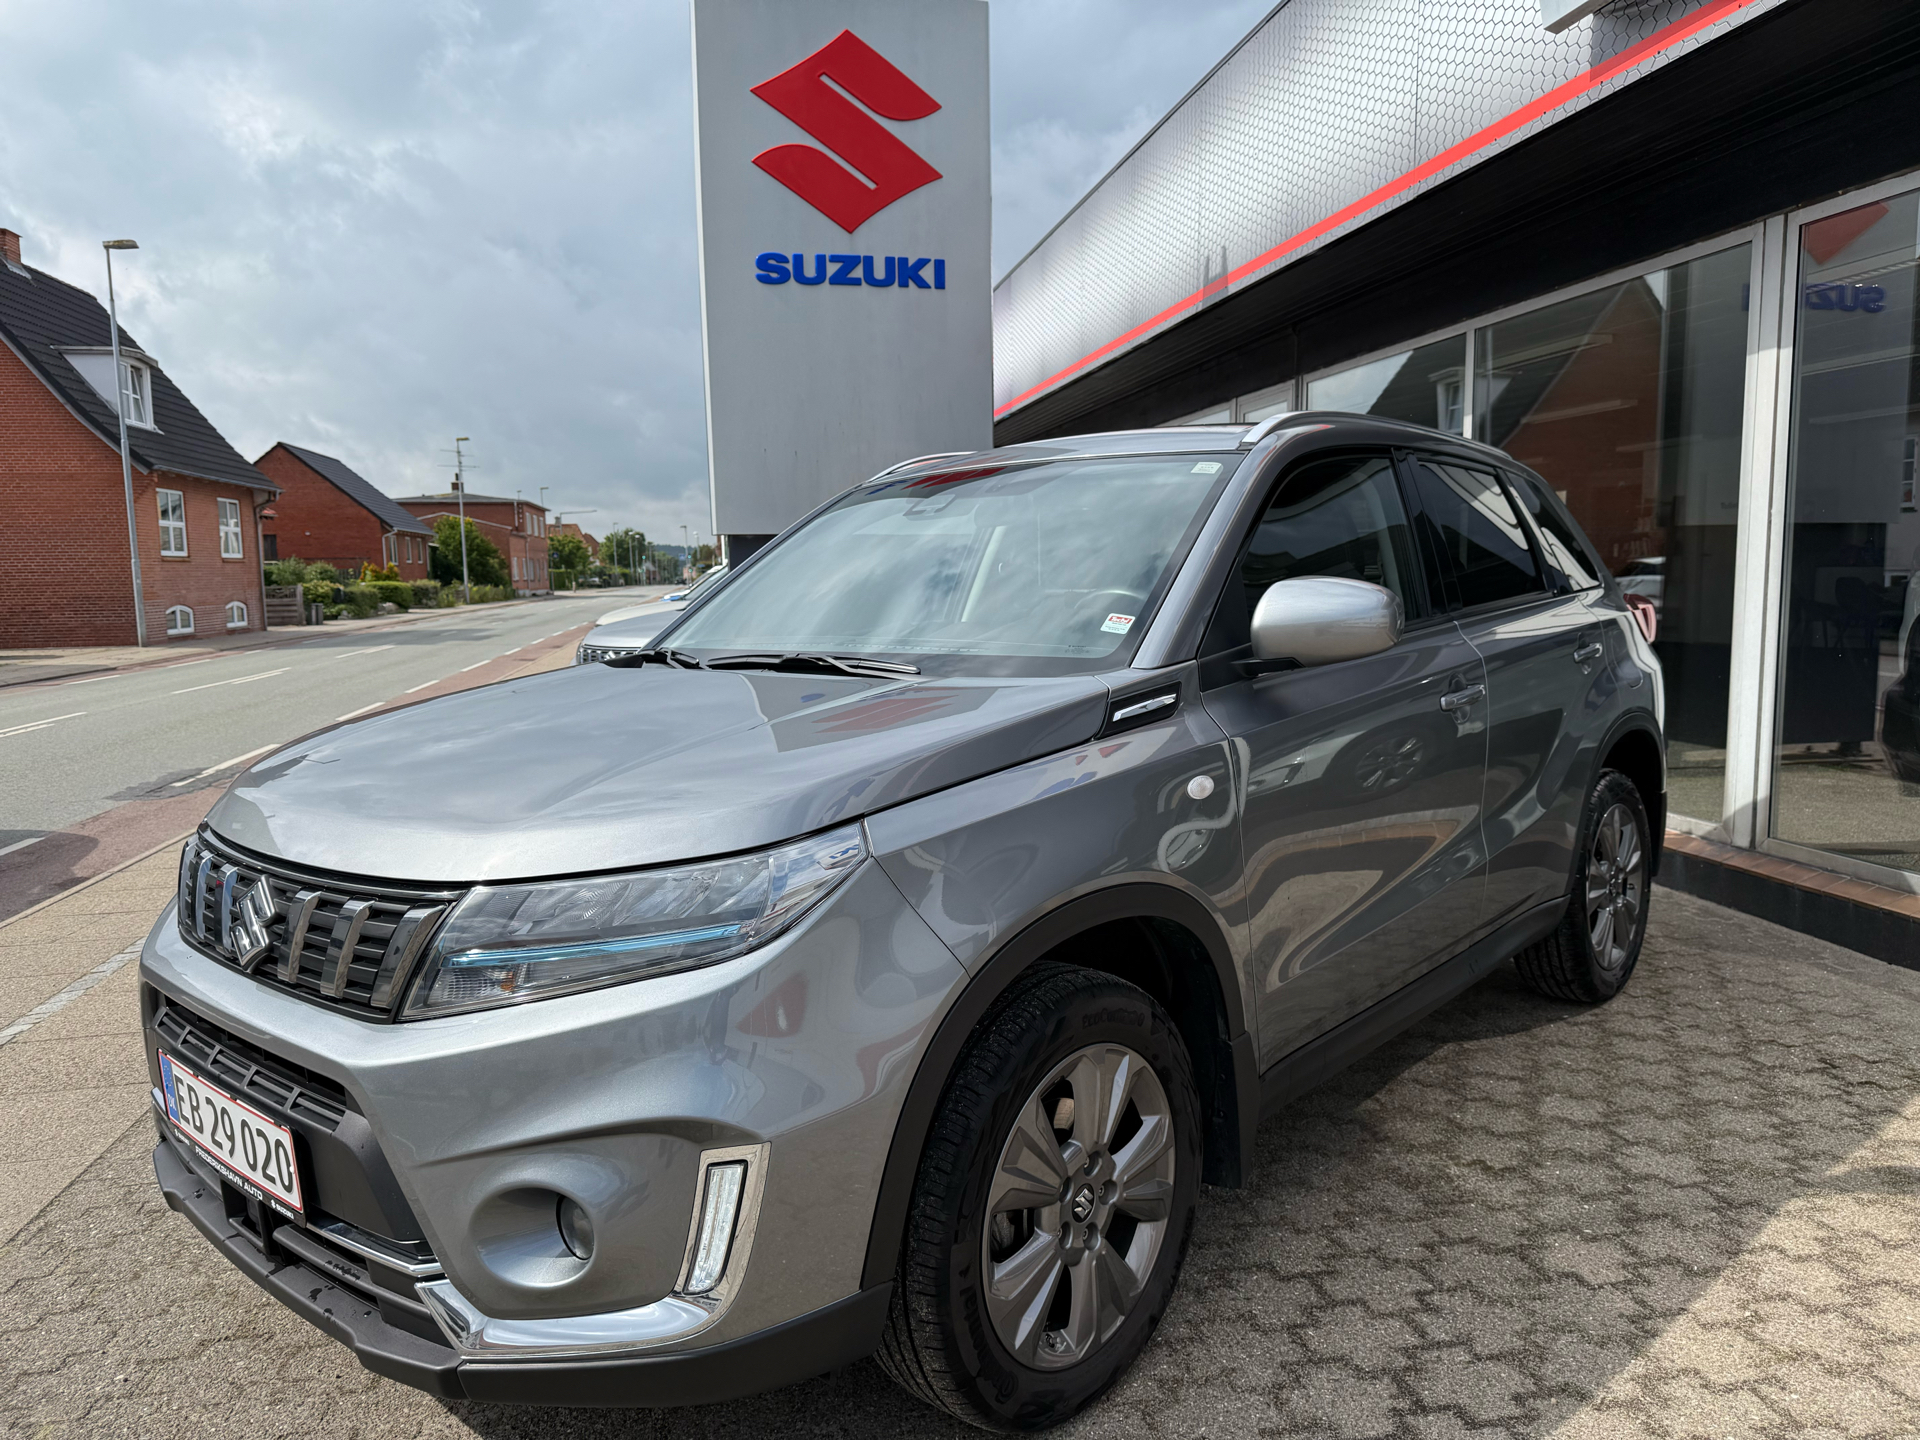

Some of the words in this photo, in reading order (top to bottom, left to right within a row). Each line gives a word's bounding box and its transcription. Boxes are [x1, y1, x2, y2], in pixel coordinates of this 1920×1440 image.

[755, 252, 945, 289] SUZUKI
[174, 1073, 204, 1134] EB
[205, 1096, 236, 1158] 29
[240, 1118, 294, 1194] 020
[243, 1178, 263, 1201] AUTO
